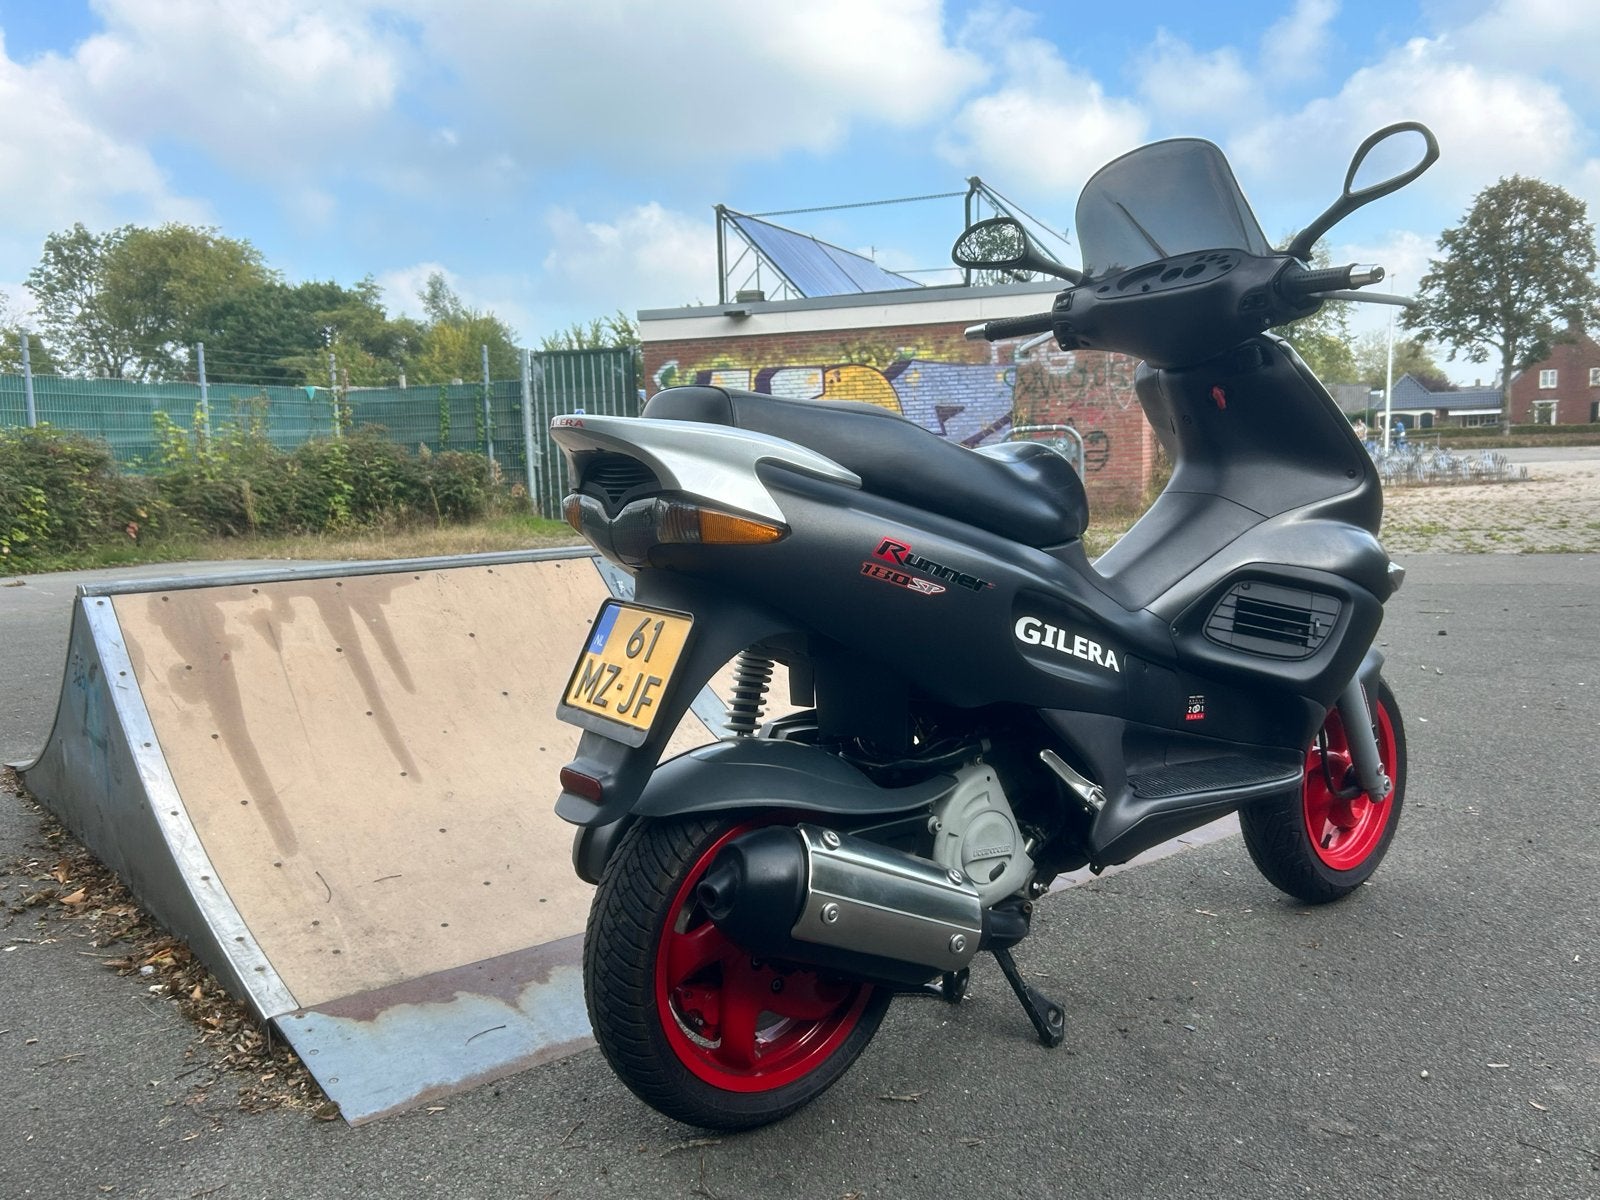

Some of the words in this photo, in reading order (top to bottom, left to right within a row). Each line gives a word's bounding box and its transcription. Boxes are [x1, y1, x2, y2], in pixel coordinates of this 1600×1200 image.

[594, 634, 603, 647] NL
[625, 617, 665, 663] 61
[1015, 616, 1120, 673] GILERA
